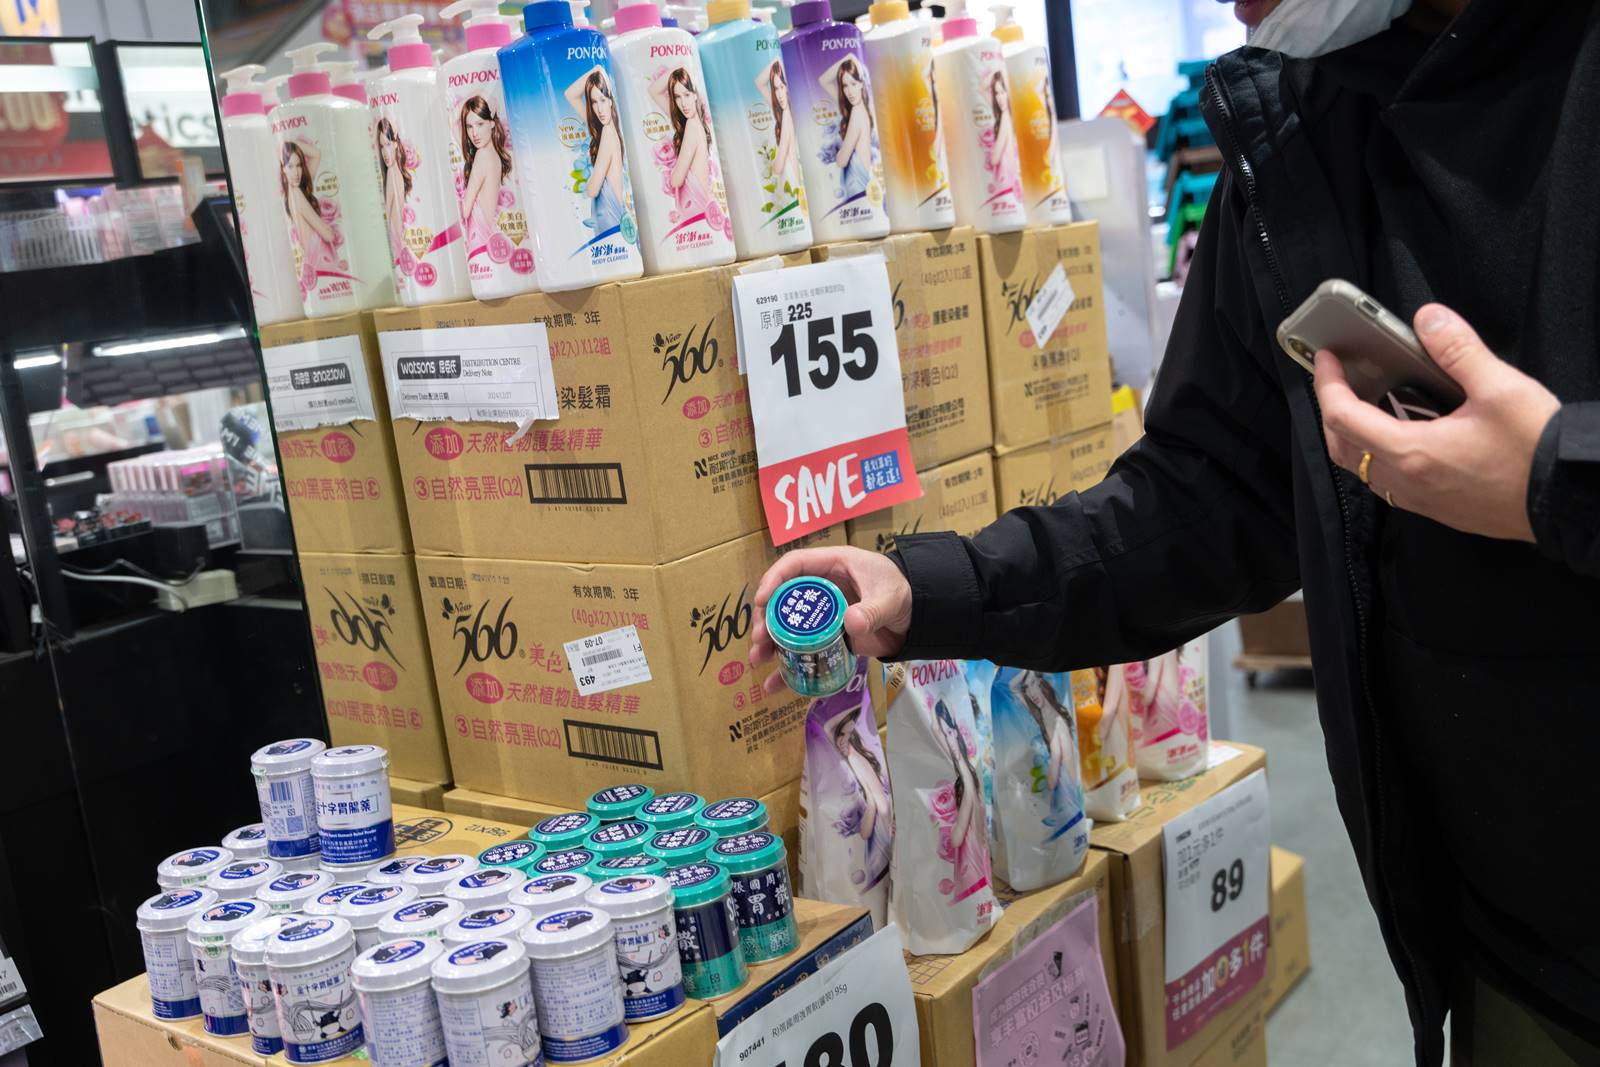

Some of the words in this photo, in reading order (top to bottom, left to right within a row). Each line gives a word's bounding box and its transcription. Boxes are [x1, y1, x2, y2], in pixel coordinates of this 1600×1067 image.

[756, 294, 778, 305] 629190
[760, 308, 784, 329] 原價
[787, 301, 813, 322] 225
[400, 360, 436, 375] watsons
[439, 359, 457, 374] 屈臣氏
[463, 369, 481, 378] Delivery
[481, 368, 493, 377] Note
[661, 316, 718, 406] 566
[770, 310, 879, 398] 155
[557, 384, 611, 410] 染髮霜
[774, 453, 867, 530] SAVE
[572, 584, 616, 600] 有效期間:
[623, 587, 640, 601] 3年
[803, 595, 829, 629] Stomachin
[453, 595, 518, 677] 566
[698, 582, 752, 677] 566
[1211, 857, 1244, 913] 89
[738, 1036, 766, 1062] 907441
[833, 983, 849, 999] 95g
